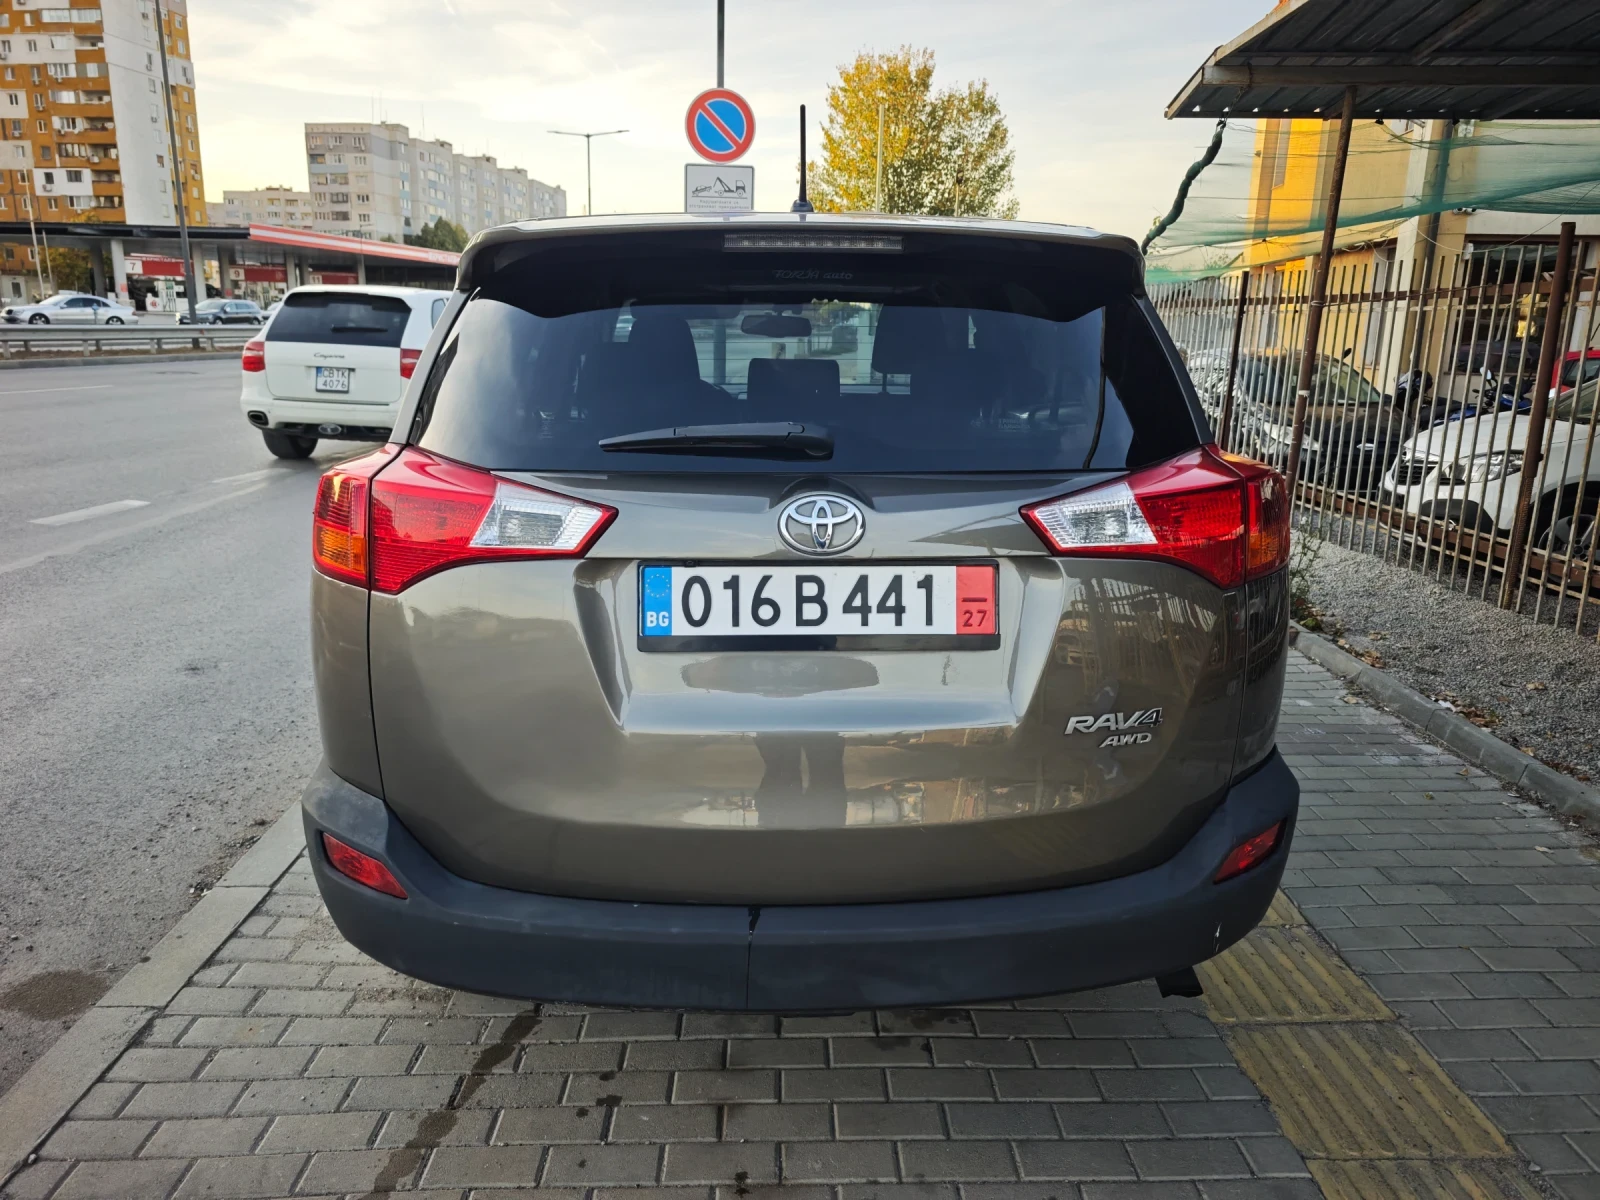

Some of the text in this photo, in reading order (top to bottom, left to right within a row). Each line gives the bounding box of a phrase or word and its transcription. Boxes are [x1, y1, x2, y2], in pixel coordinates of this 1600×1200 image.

[130, 262, 136, 271] 7
[234, 270, 240, 278] 9
[823, 271, 854, 280] auto
[322, 380, 347, 389] 4076
[646, 611, 670, 627] BG
[962, 609, 988, 628] 27
[1064, 707, 1163, 735] RAV4
[1099, 732, 1152, 748] AWD
